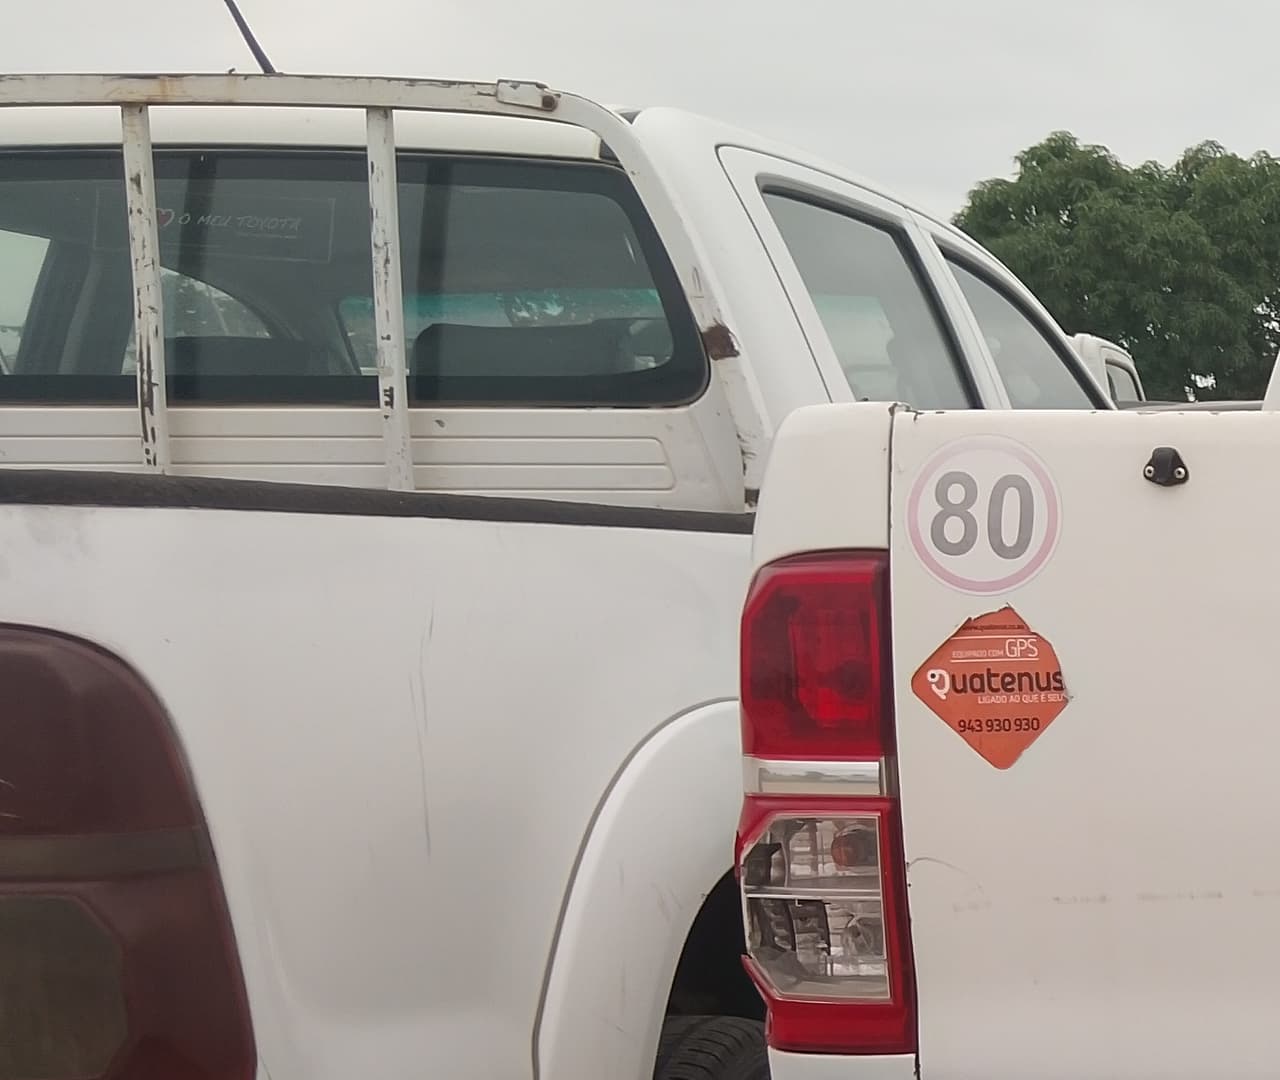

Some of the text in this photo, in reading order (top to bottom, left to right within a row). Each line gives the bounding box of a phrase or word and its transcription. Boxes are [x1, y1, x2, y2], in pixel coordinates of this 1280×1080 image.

[930, 470, 1035, 560] 80
[1005, 638, 1039, 658] GPS
[978, 695, 1008, 704] LIGADO
[1009, 695, 1021, 703] AO
[1022, 694, 1039, 704] QUE
[958, 717, 1040, 732] 943 930 930
